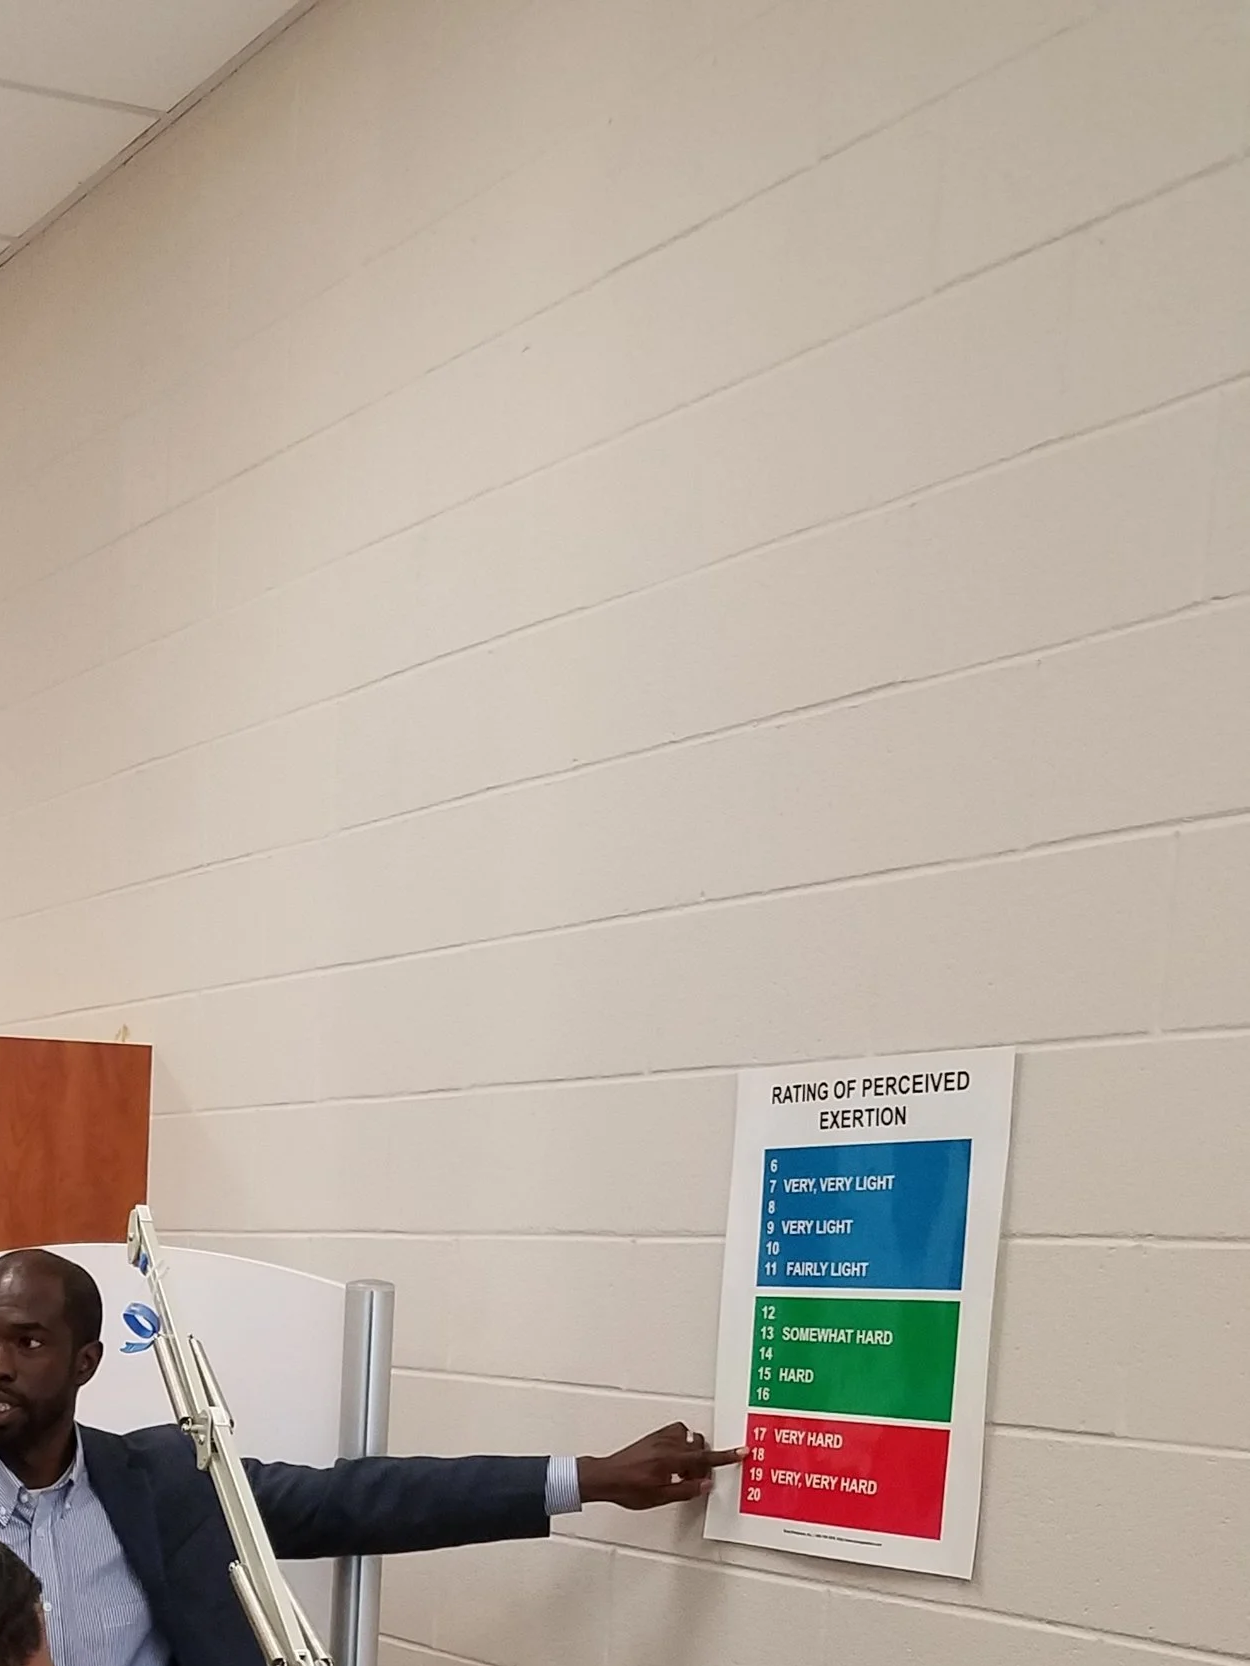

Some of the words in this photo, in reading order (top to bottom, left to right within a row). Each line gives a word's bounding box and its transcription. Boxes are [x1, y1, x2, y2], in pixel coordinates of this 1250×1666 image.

[772, 1082, 828, 1104] RATING
[833, 1079, 856, 1100] OF
[862, 1071, 970, 1097] PERCEIVED
[819, 1106, 907, 1130] EXERTION
[770, 1159, 778, 1173] 6
[769, 1180, 777, 1193] 7
[783, 1178, 817, 1194] VERY,
[819, 1177, 853, 1192] VERY
[855, 1175, 895, 1191] LIGHT
[768, 1200, 776, 1214] 8
[766, 1221, 775, 1235] 9
[781, 1220, 814, 1235] VERY
[815, 1219, 854, 1235] LIGHT
[766, 1241, 780, 1255] 10
[765, 1261, 777, 1276] 11
[786, 1262, 829, 1277] FAIRLY
[830, 1262, 869, 1277] LIGHT
[761, 1305, 776, 1320] 12
[760, 1326, 774, 1340] 13
[782, 1326, 854, 1343] SOMEWHAT
[856, 1330, 893, 1345] HARD
[759, 1347, 773, 1360] 14
[758, 1366, 771, 1380] 15
[779, 1367, 814, 1383] HARD
[756, 1387, 770, 1401] 16
[753, 1427, 767, 1441] 17
[774, 1428, 805, 1446] VERY
[807, 1432, 843, 1449] HARD
[751, 1447, 765, 1461] 18
[750, 1467, 763, 1481] 19
[770, 1469, 802, 1488] VERY,
[805, 1473, 838, 1490] VERY
[840, 1478, 878, 1495] HARD
[747, 1487, 761, 1502] 20
